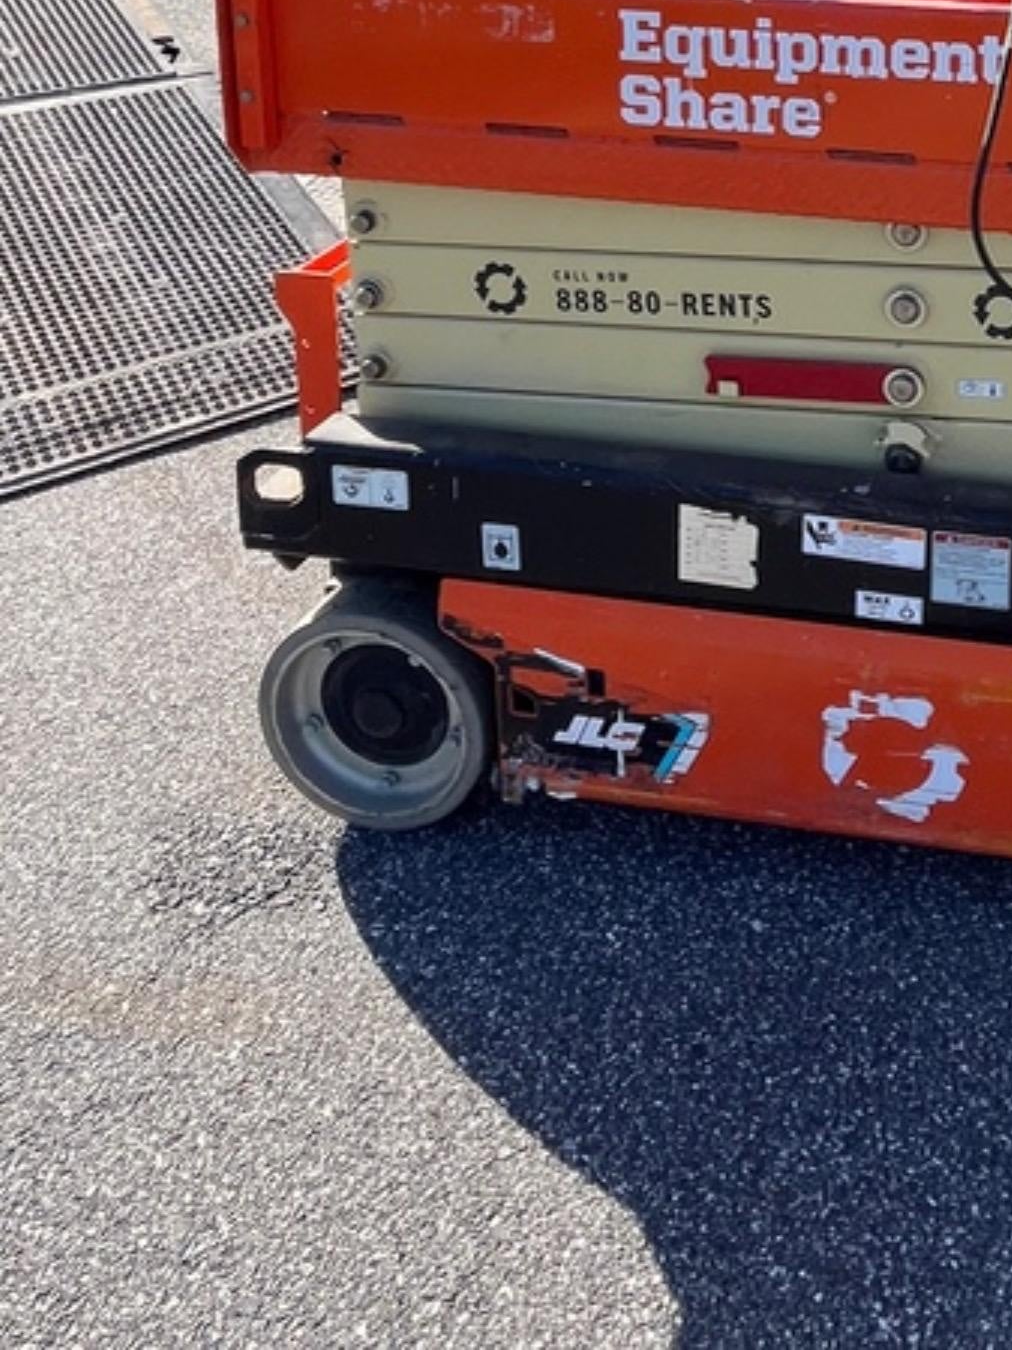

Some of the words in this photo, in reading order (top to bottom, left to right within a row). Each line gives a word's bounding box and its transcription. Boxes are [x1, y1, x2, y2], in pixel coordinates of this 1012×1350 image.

[618, 9, 1005, 84] Equipment
[619, 74, 822, 138] Share
[552, 269, 590, 283] CALL
[596, 271, 629, 283] NOW
[555, 288, 773, 319] 888-80-RENTS
[553, 714, 646, 751] JLG
